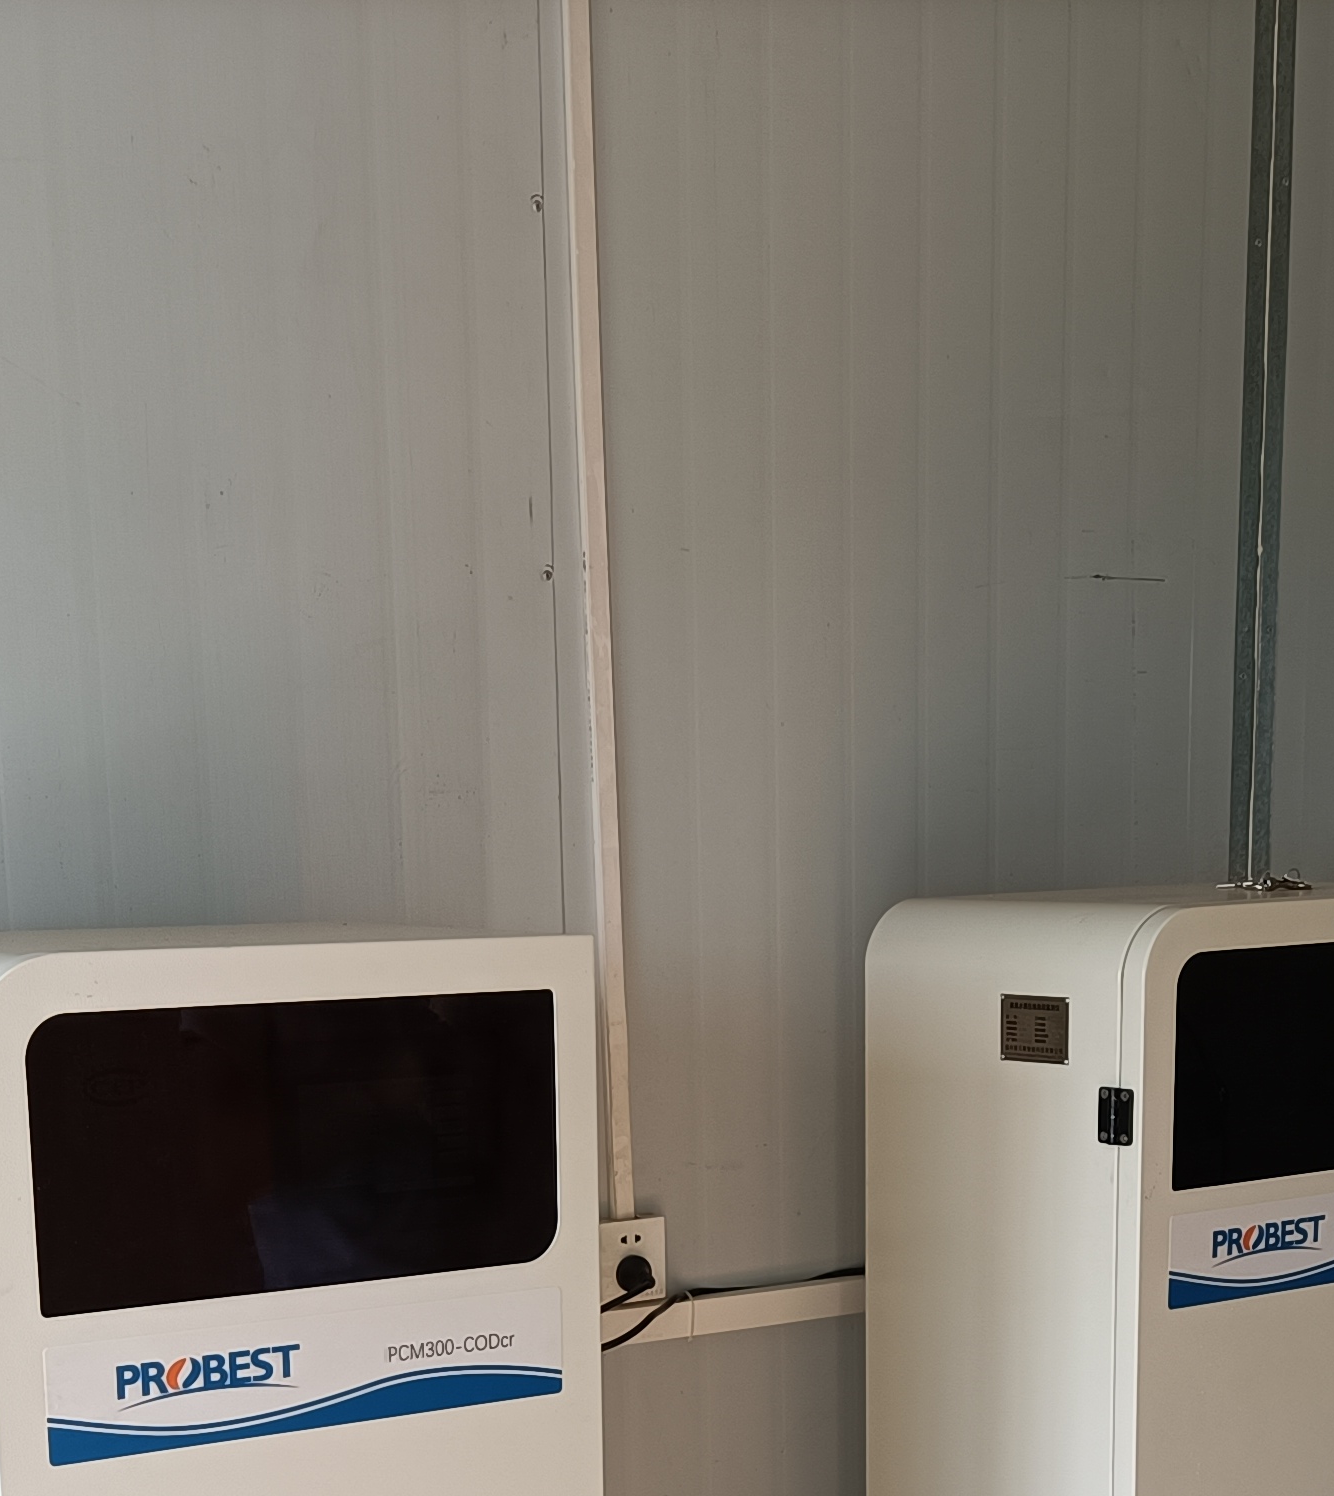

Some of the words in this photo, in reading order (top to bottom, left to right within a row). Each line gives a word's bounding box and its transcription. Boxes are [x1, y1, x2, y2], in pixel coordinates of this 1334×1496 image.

[1212, 1214, 1326, 1259] PROBEST
[387, 1332, 515, 1364] PCM300-CODcr
[115, 1343, 300, 1400] PROBEST
